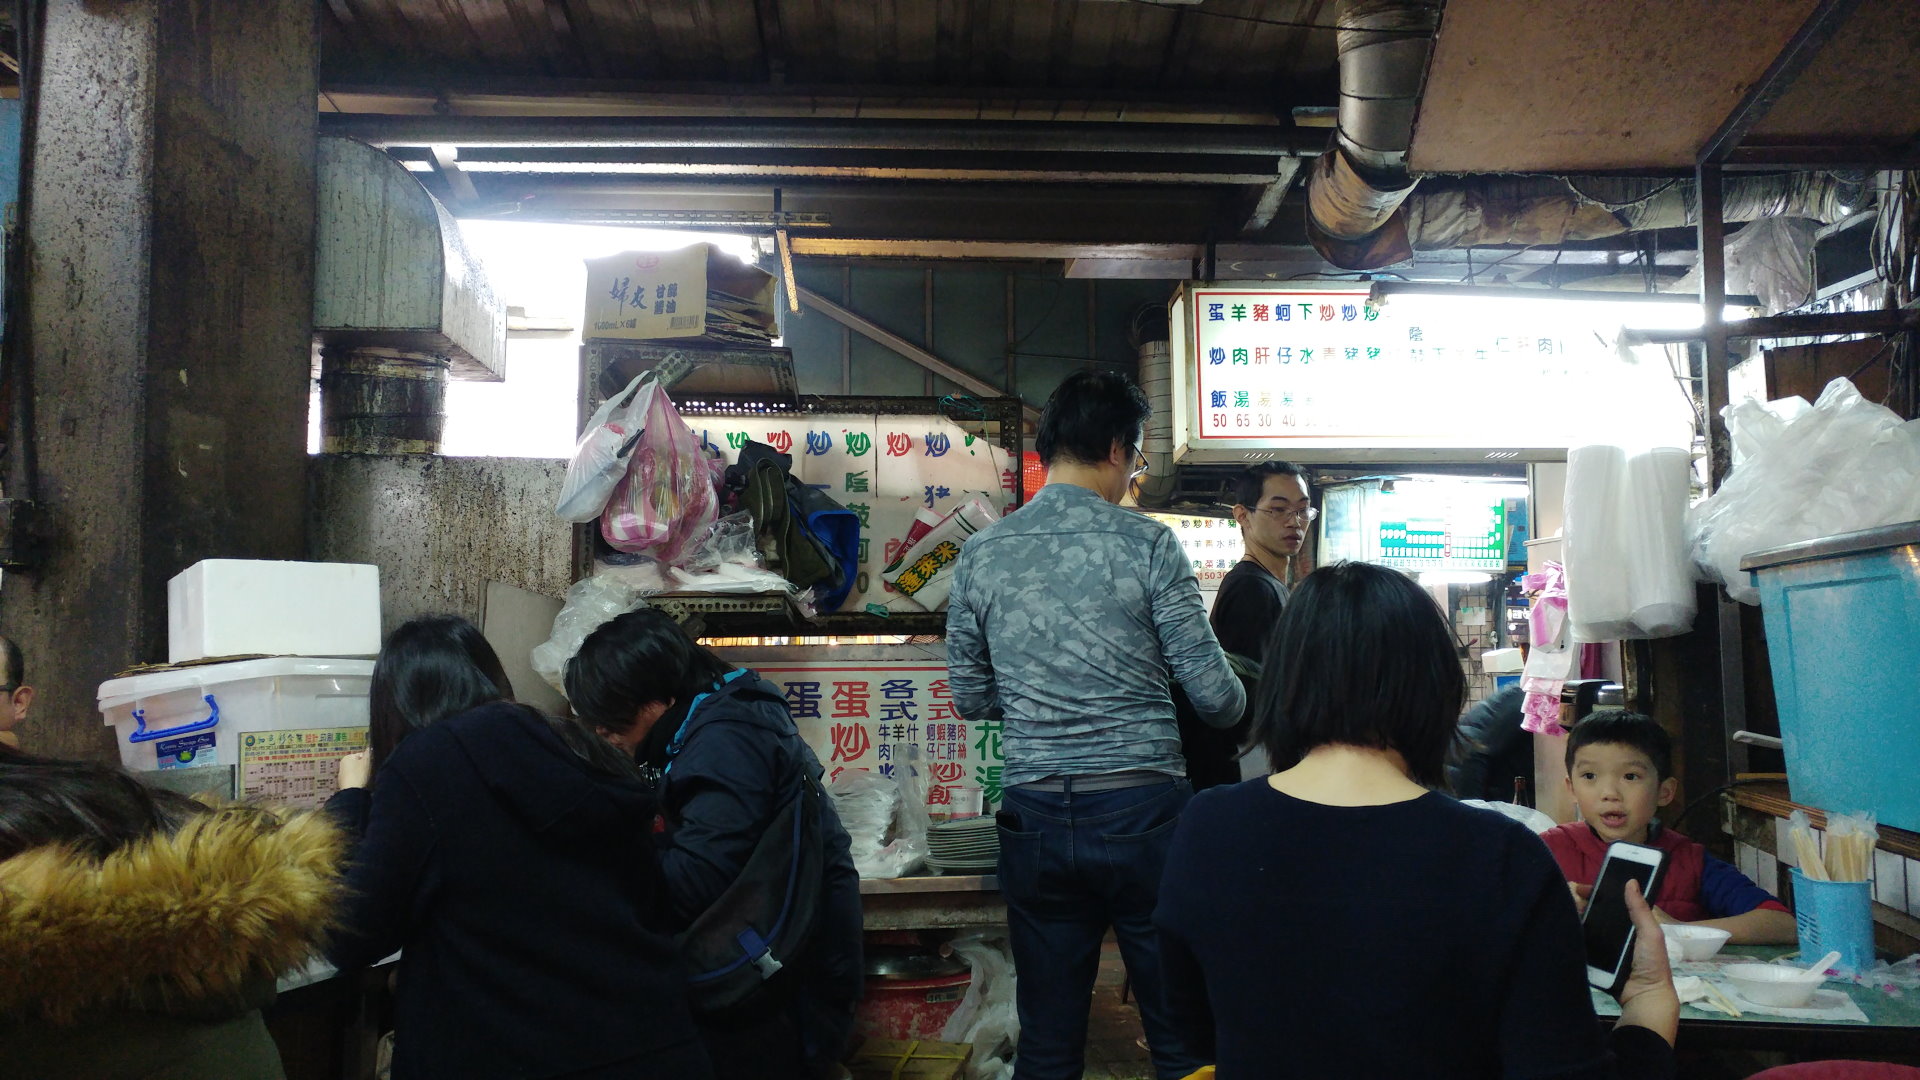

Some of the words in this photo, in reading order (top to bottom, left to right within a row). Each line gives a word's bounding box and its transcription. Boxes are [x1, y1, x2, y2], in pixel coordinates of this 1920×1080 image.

[1208, 303, 1228, 408] 蛋炒飯
[1230, 303, 1250, 408] 羊肉湯
[1212, 413, 1228, 428] 50
[1236, 413, 1251, 427] 65
[1257, 413, 1272, 427] 30
[1281, 413, 1296, 427] 40
[1204, 571, 1216, 580] 50
[783, 681, 823, 719] 蛋
[879, 679, 918, 721] 各式
